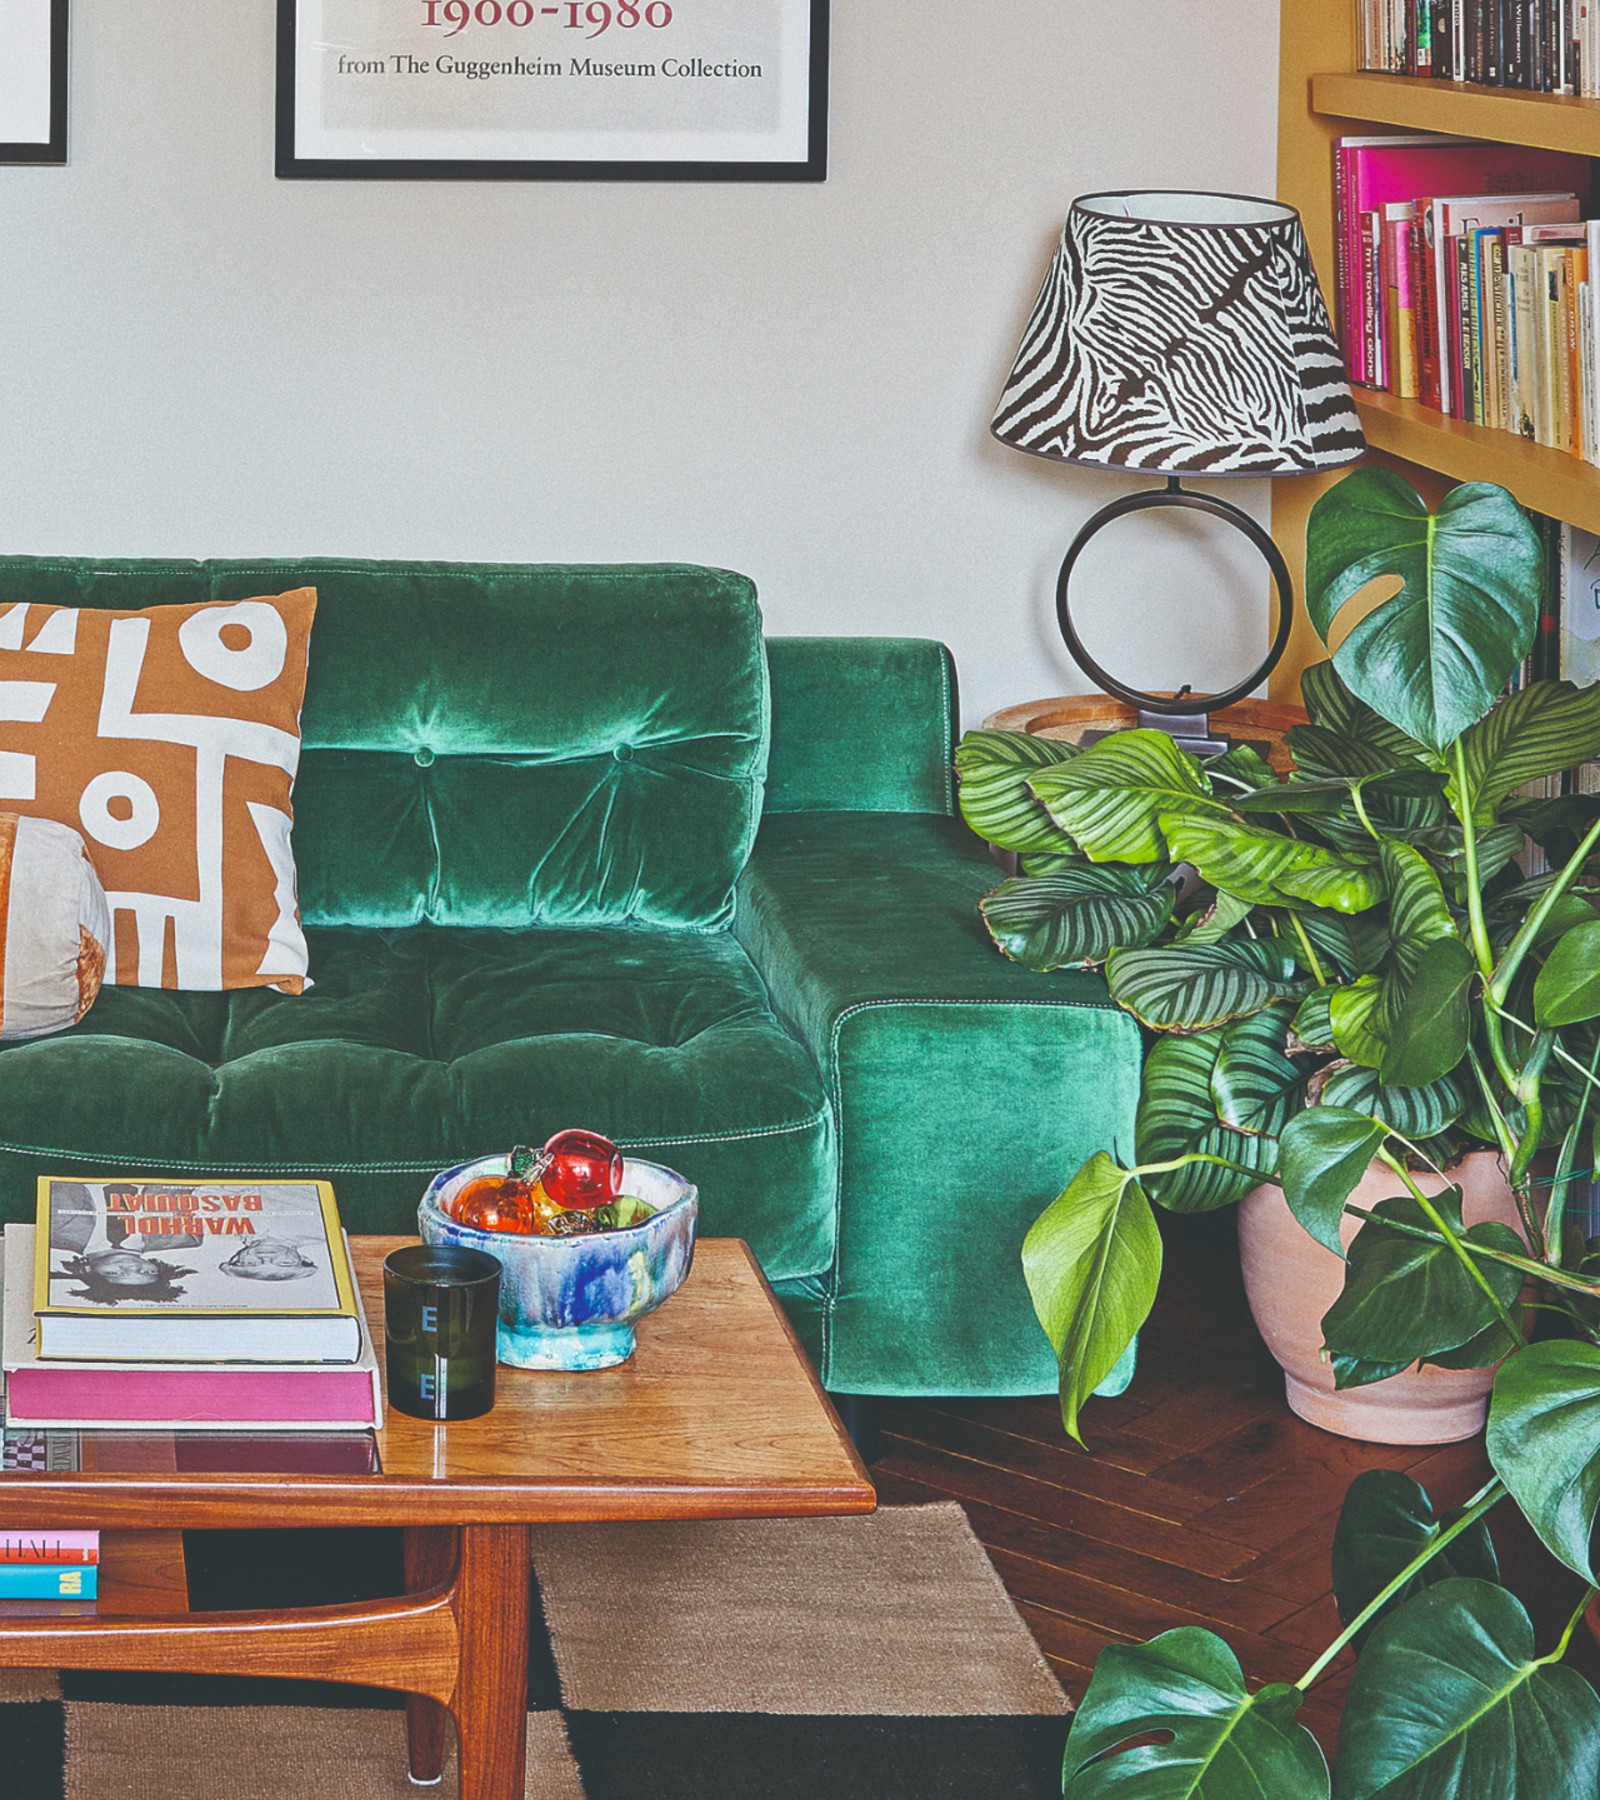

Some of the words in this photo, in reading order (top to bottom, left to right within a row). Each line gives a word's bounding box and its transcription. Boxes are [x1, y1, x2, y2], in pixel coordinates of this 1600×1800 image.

[421, 0, 673, 39] 1900-1980
[338, 54, 385, 74] from
[390, 54, 430, 74] The
[435, 54, 562, 79] Guggenheim
[569, 58, 656, 77] Museum
[661, 58, 762, 78] Collection
[1365, 271, 1374, 333] travelling
[1367, 338, 1375, 378] alone
[106, 1193, 263, 1212] BASQUIAT
[117, 1215, 256, 1235] WARHOL
[422, 1305, 437, 1332] E
[421, 1373, 435, 1400] E
[5, 1539, 70, 1558] HALL
[59, 1571, 82, 1594] RA
